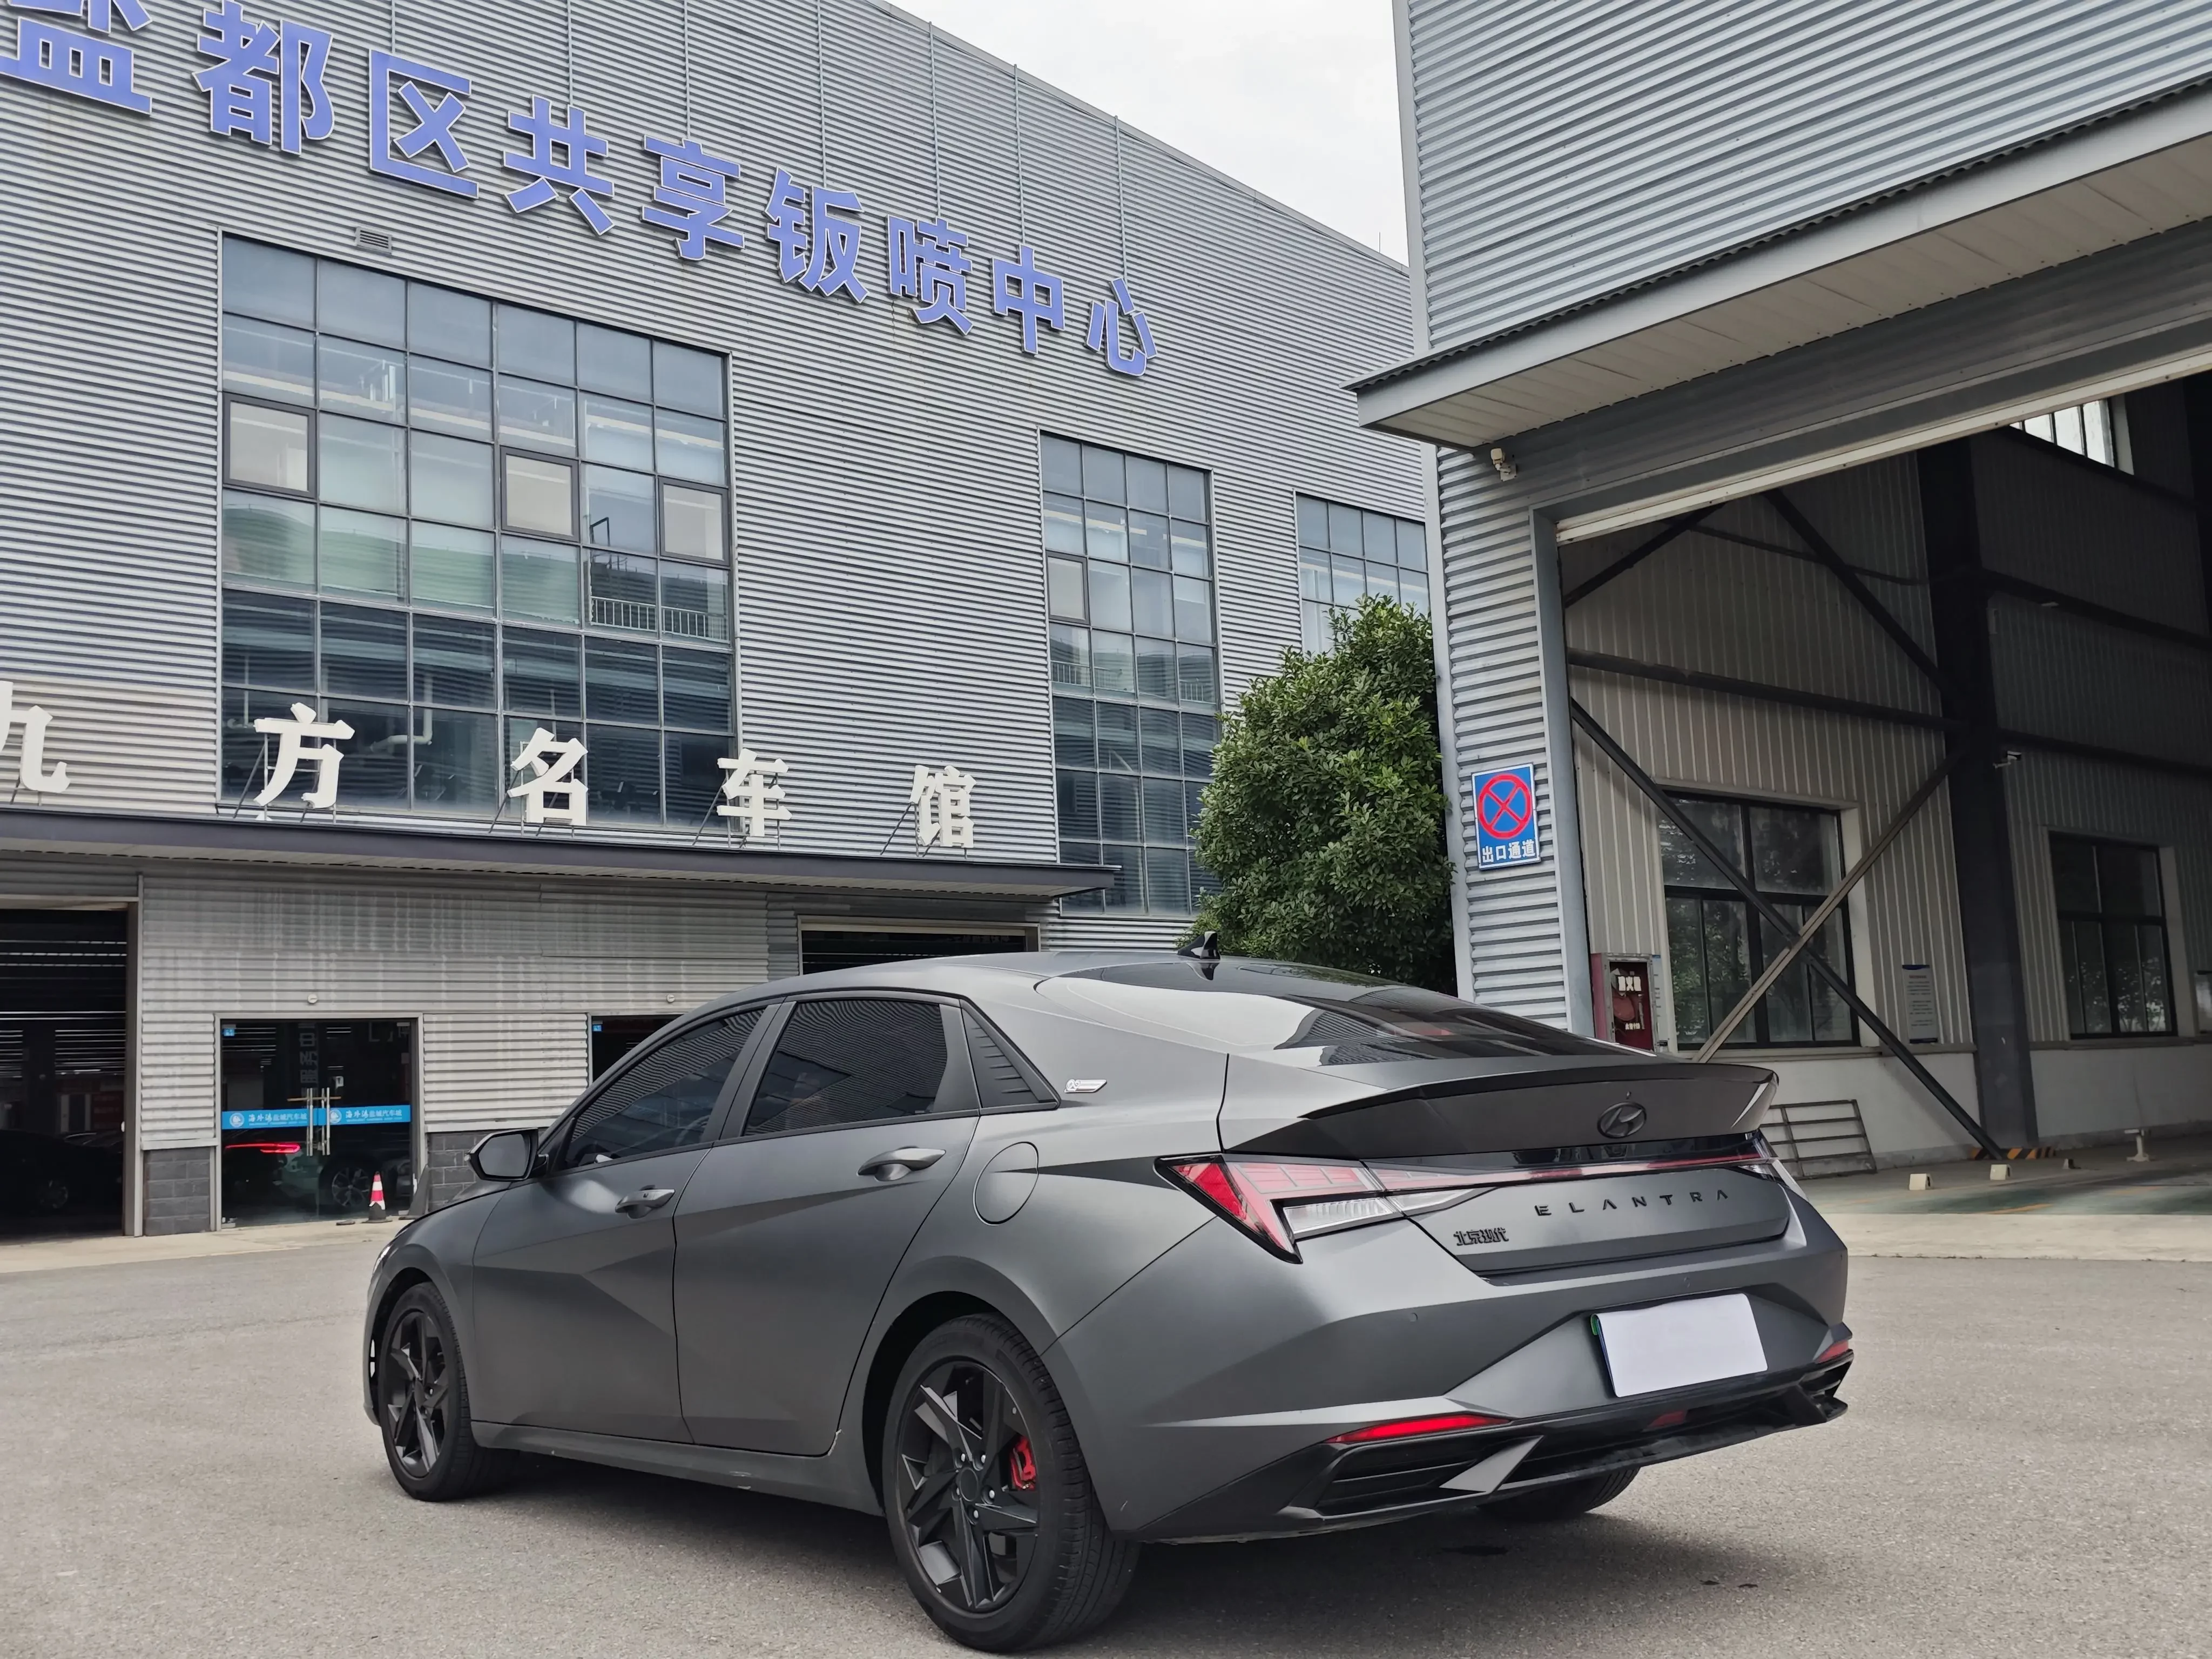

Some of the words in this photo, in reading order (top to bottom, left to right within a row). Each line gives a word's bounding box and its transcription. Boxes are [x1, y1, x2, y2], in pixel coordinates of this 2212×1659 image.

[0, 680, 976, 849] 九方名车馆
[1482, 839, 1535, 862] 出口通道
[1534, 1190, 1729, 1216] ELANTRA
[1453, 1226, 1509, 1246] 北京现代
